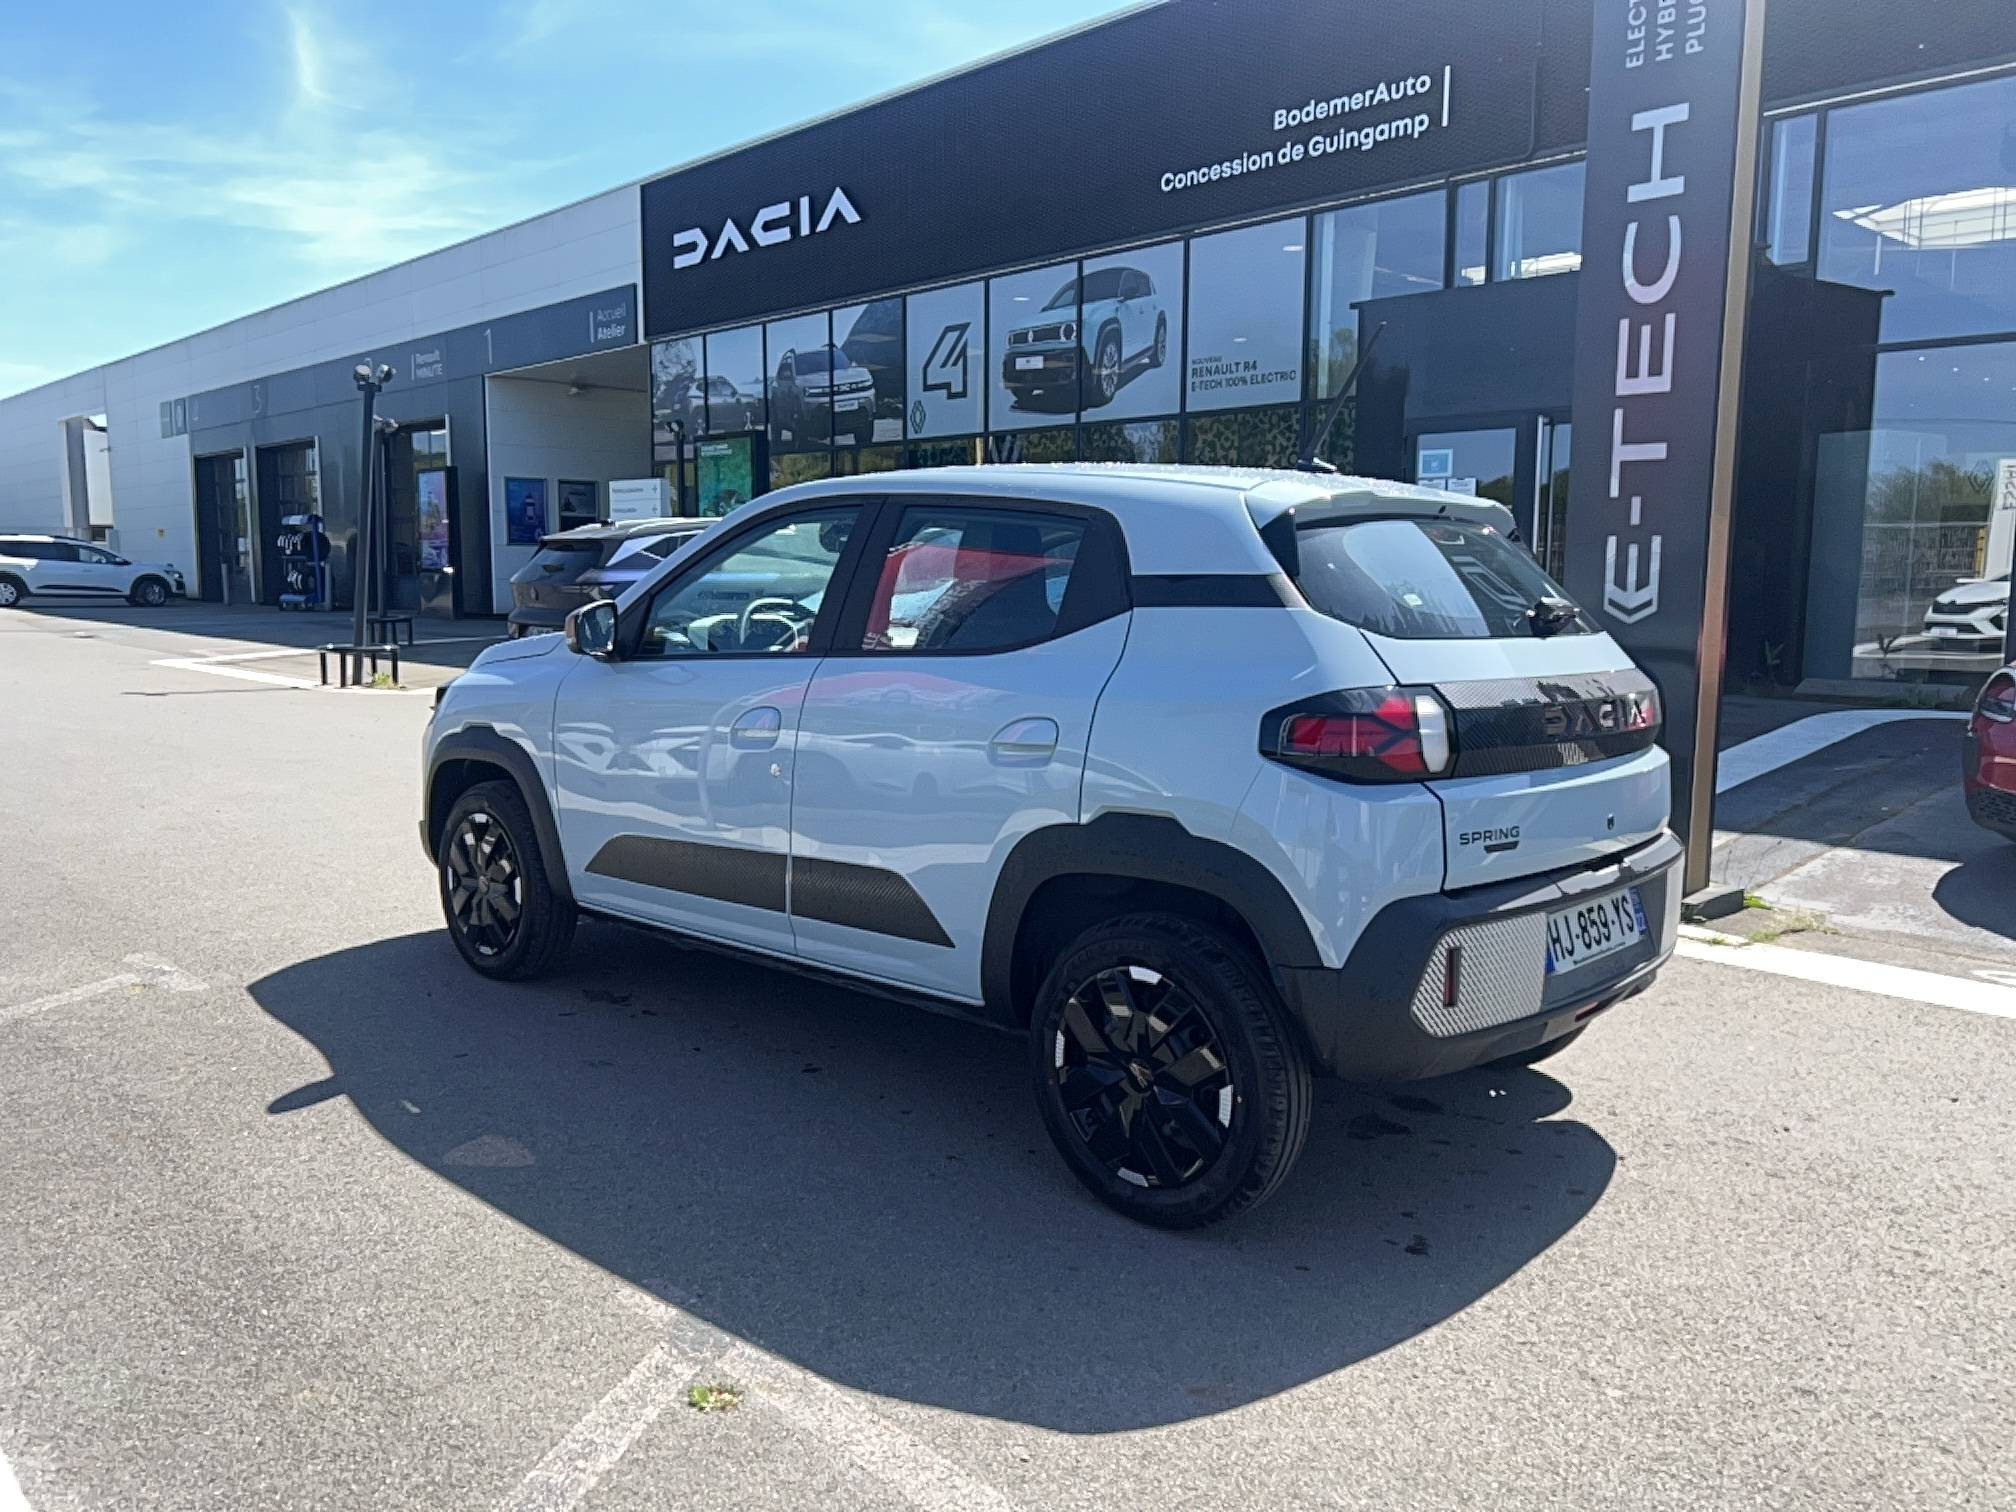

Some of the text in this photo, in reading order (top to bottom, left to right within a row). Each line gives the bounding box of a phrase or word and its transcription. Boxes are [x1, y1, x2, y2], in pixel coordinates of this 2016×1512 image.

[1272, 74, 1432, 131] BodemerAuto
[1160, 113, 1429, 192] Concession de Guingamp
[672, 186, 862, 270] DACIA
[483, 328, 493, 365] 1
[597, 324, 626, 340] Atelier
[1191, 360, 1258, 378] RENAULT R4
[1191, 370, 1297, 392] E-TECH 100% ELECTRIC
[1602, 101, 1691, 625] E-TECH
[1459, 825, 1520, 846] SPRING
[1548, 896, 1635, 962] HJ-859-YS
